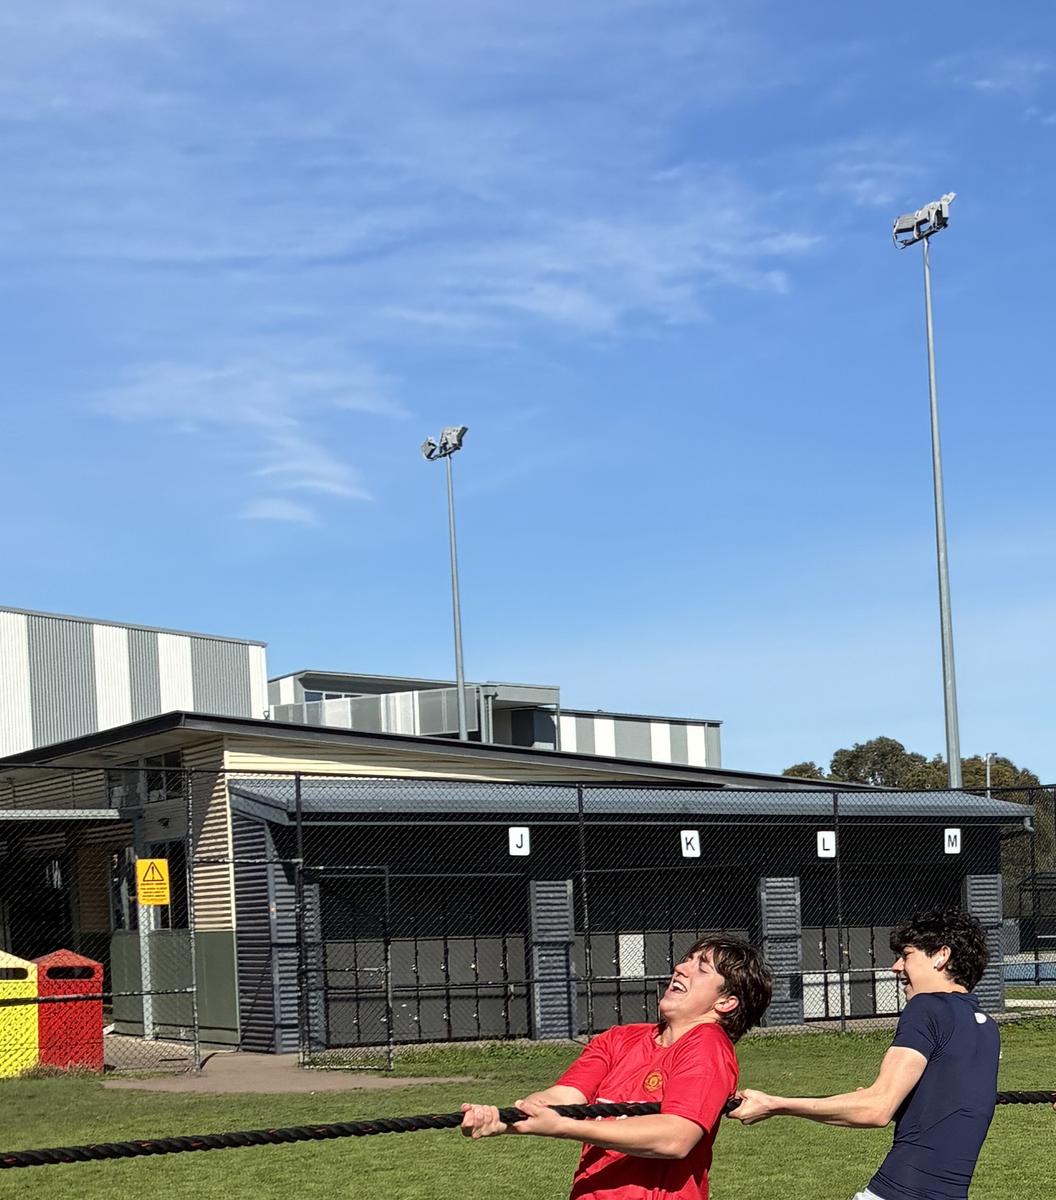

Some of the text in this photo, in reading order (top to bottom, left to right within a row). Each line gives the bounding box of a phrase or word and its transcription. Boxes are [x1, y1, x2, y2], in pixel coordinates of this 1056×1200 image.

[515, 834, 524, 848] J
[685, 836, 696, 851] K
[822, 837, 831, 851] L
[947, 834, 958, 848] M
